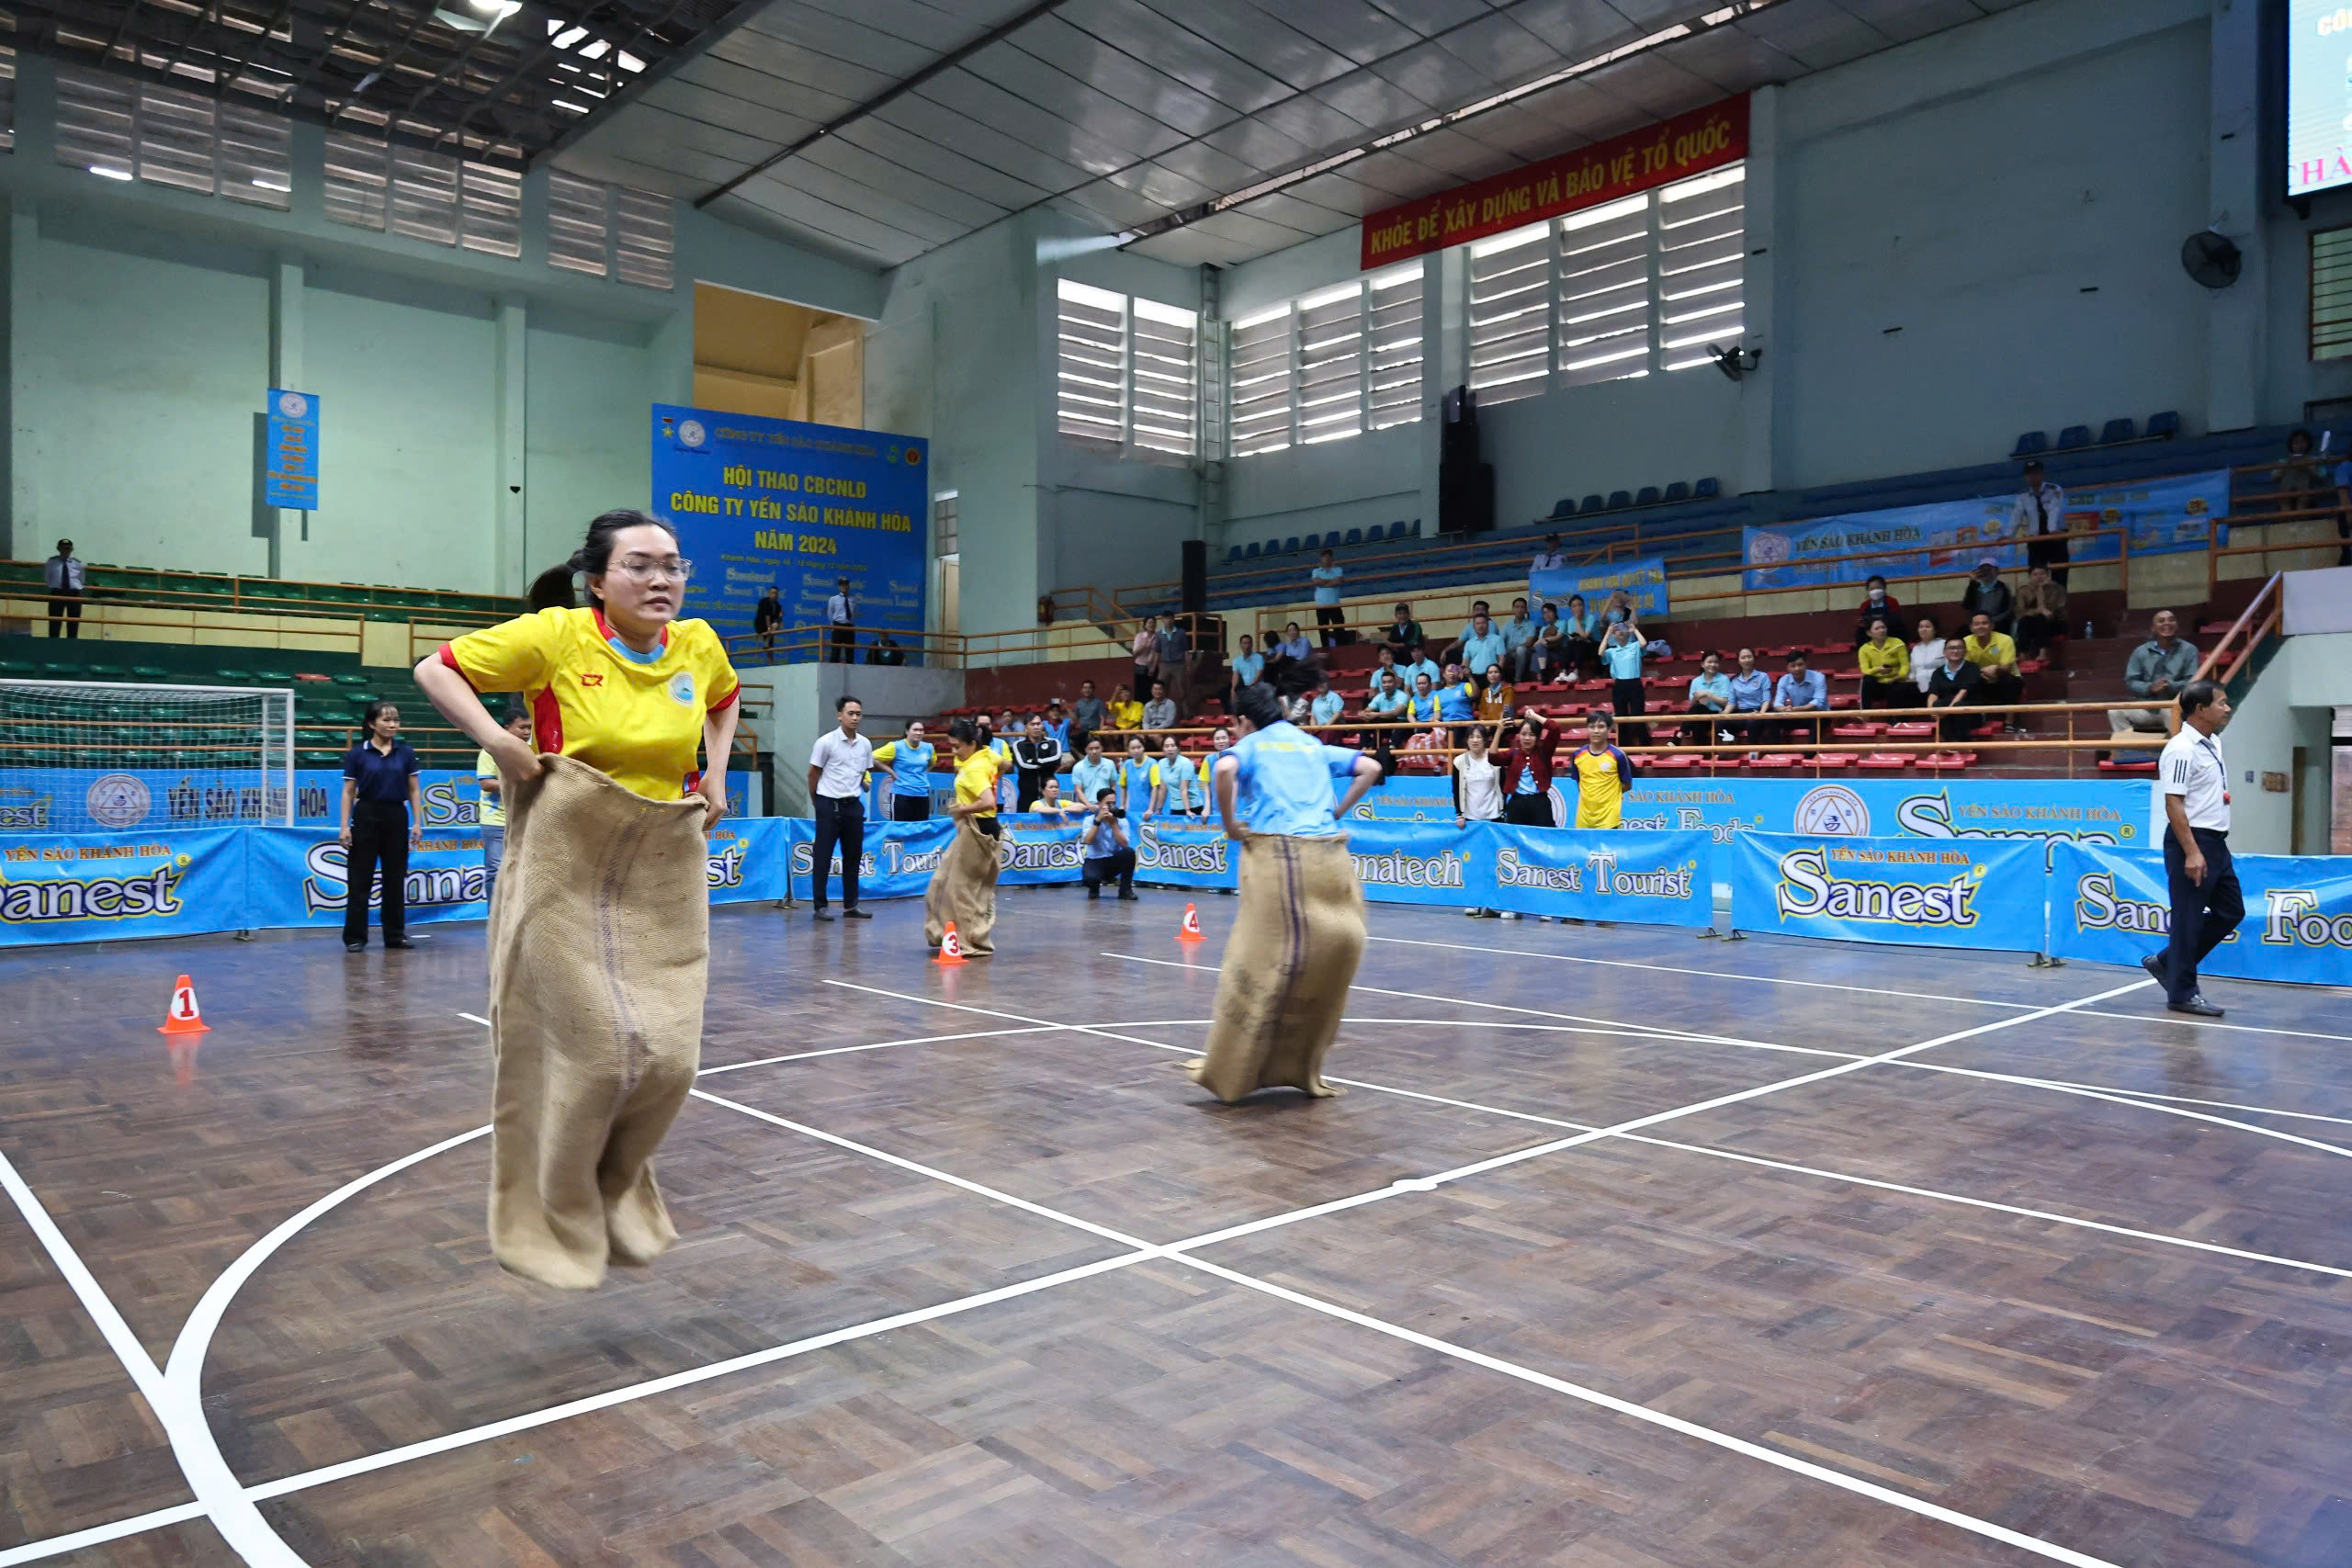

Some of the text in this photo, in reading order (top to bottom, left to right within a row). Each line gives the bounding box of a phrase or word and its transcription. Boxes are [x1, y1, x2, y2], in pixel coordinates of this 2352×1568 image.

[1418, 199, 1442, 241] ĐỂ
[1444, 198, 1477, 234] XÂY
[1482, 186, 1532, 225] DỰNG
[1535, 171, 1560, 207] VÀ
[1566, 157, 1605, 199] BẢO
[1611, 147, 1635, 186] VỆ
[1642, 127, 1670, 175] TỔ
[1674, 114, 1731, 167] QUỐC
[723, 464, 752, 490] HỘI
[757, 469, 797, 491] THAO
[671, 491, 911, 533] CÔNG TY YẾN SÀO KHÁNH HÒA
[754, 529, 838, 555] NĂM 2024
[298, 779, 329, 818] HÒA
[1656, 788, 1703, 803] KHÁNH
[1705, 787, 1735, 803] HÒA
[1958, 804, 2121, 821] YẾN SÀO KHÁNH HÒA
[4, 841, 172, 862] YẾN SÀO KHÁNH HÒA
[792, 839, 943, 876] Snst Touri
[1137, 823, 1227, 872] Sanest
[1830, 845, 1971, 865] YẾN SÀO KHÁNH HÒA
[1351, 850, 1464, 888] anatech
[1498, 848, 1692, 898] Sanest Tourist
[0, 864, 181, 919] anest
[1779, 848, 1978, 926] Sanest
[1189, 912, 1199, 931] 4
[949, 933, 959, 953] 3
[178, 988, 194, 1017] 1
